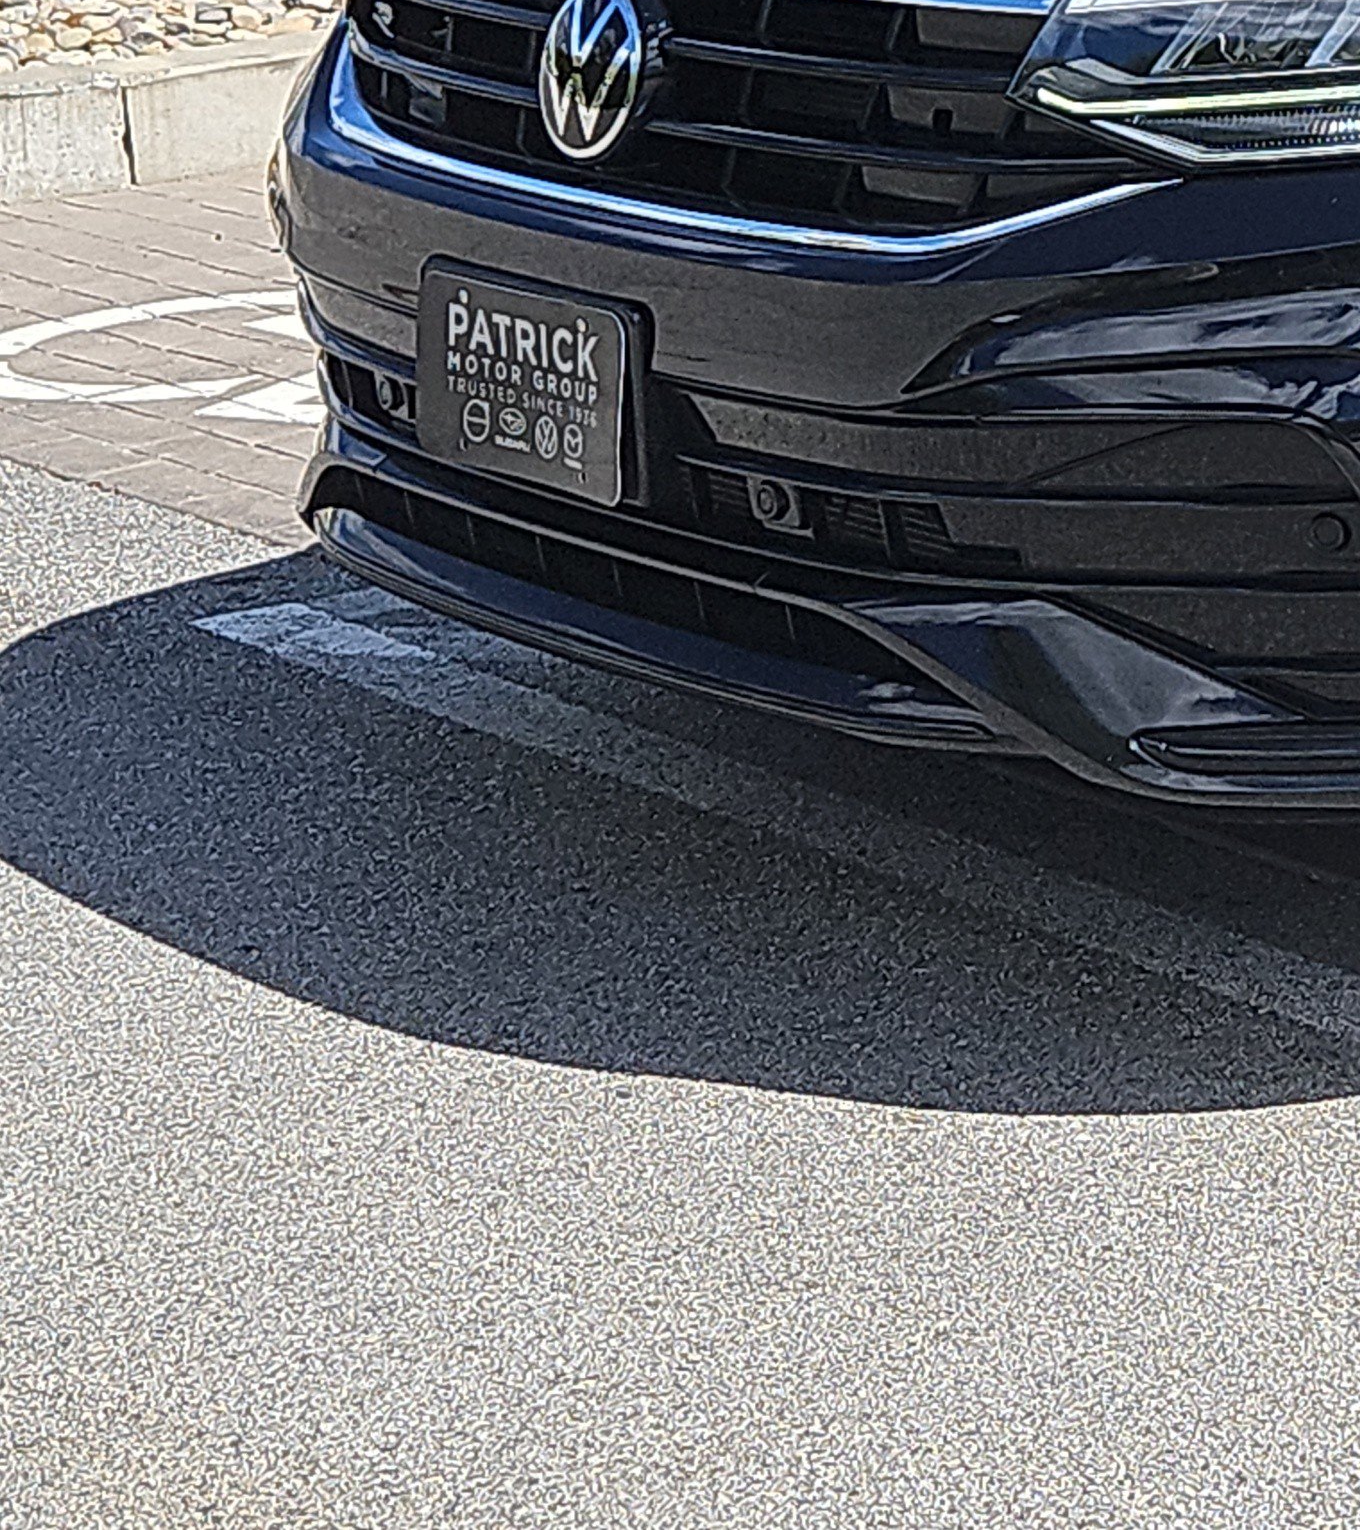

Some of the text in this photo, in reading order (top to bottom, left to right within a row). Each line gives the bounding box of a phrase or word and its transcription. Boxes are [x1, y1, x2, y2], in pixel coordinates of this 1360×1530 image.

[448, 301, 600, 383] PATRICK
[446, 349, 598, 406] MOTOR GROUP
[446, 374, 517, 405] TRUSTED
[521, 391, 564, 418] SINCE
